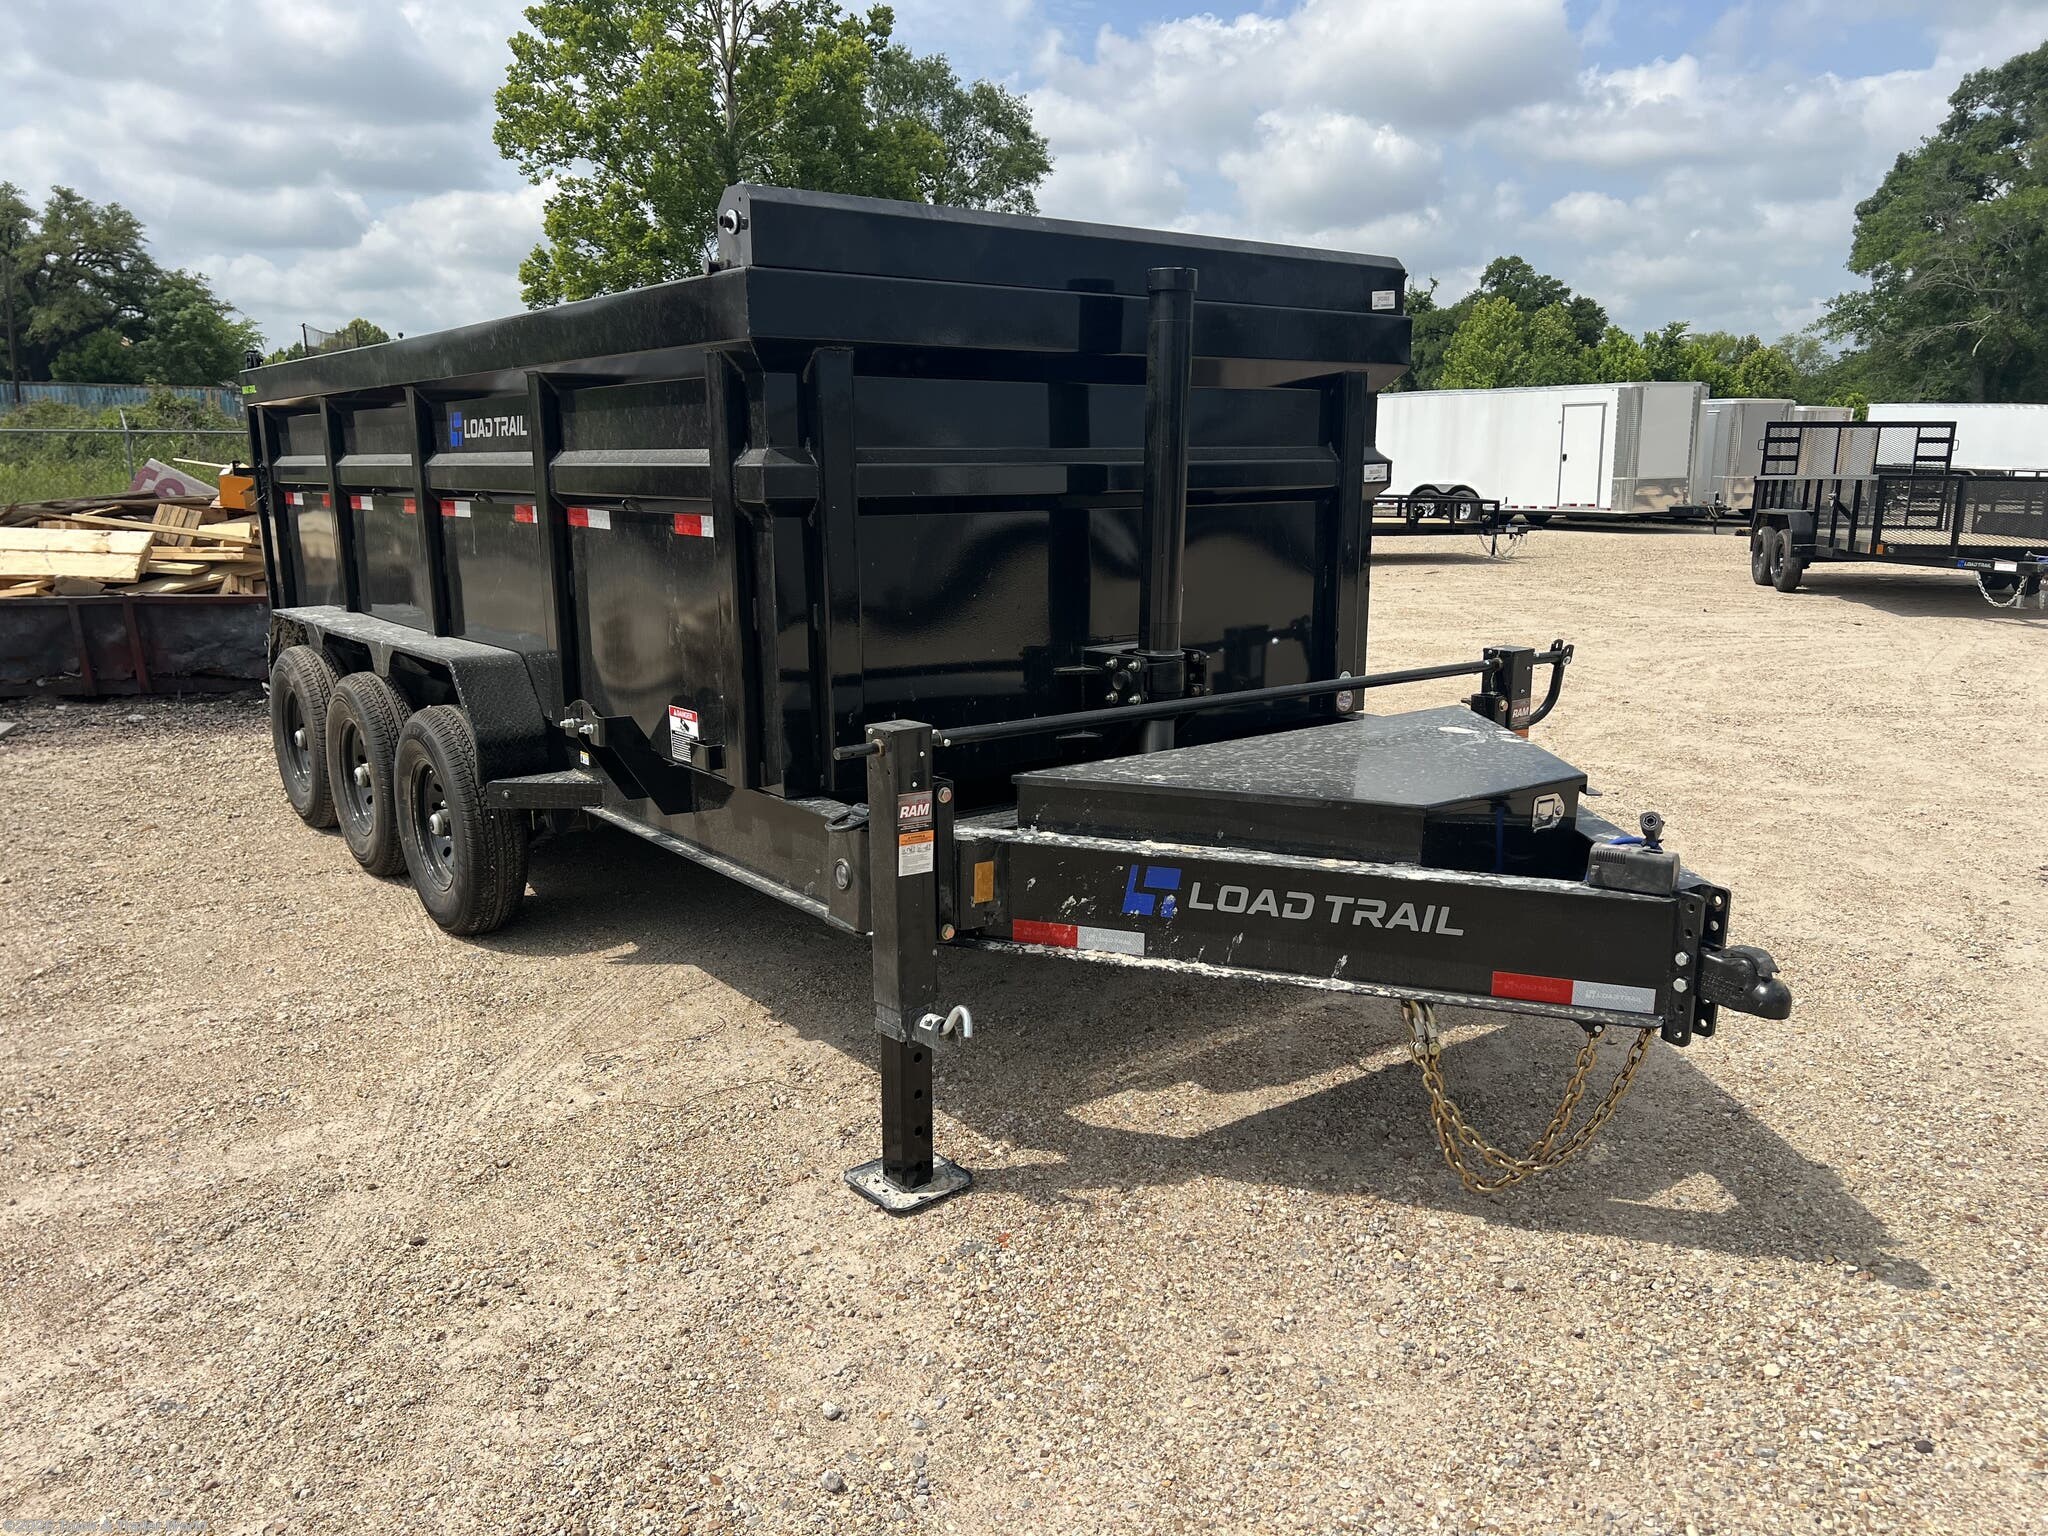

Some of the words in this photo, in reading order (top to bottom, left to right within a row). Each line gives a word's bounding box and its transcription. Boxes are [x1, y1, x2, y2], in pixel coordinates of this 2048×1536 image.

[463, 417, 493, 439] LOAD
[493, 415, 528, 437] TRAIL
[1512, 706, 1530, 719] RAM
[899, 803, 930, 819] RAM
[1188, 881, 1316, 920] LOAD
[1324, 894, 1465, 937] TRAIL
